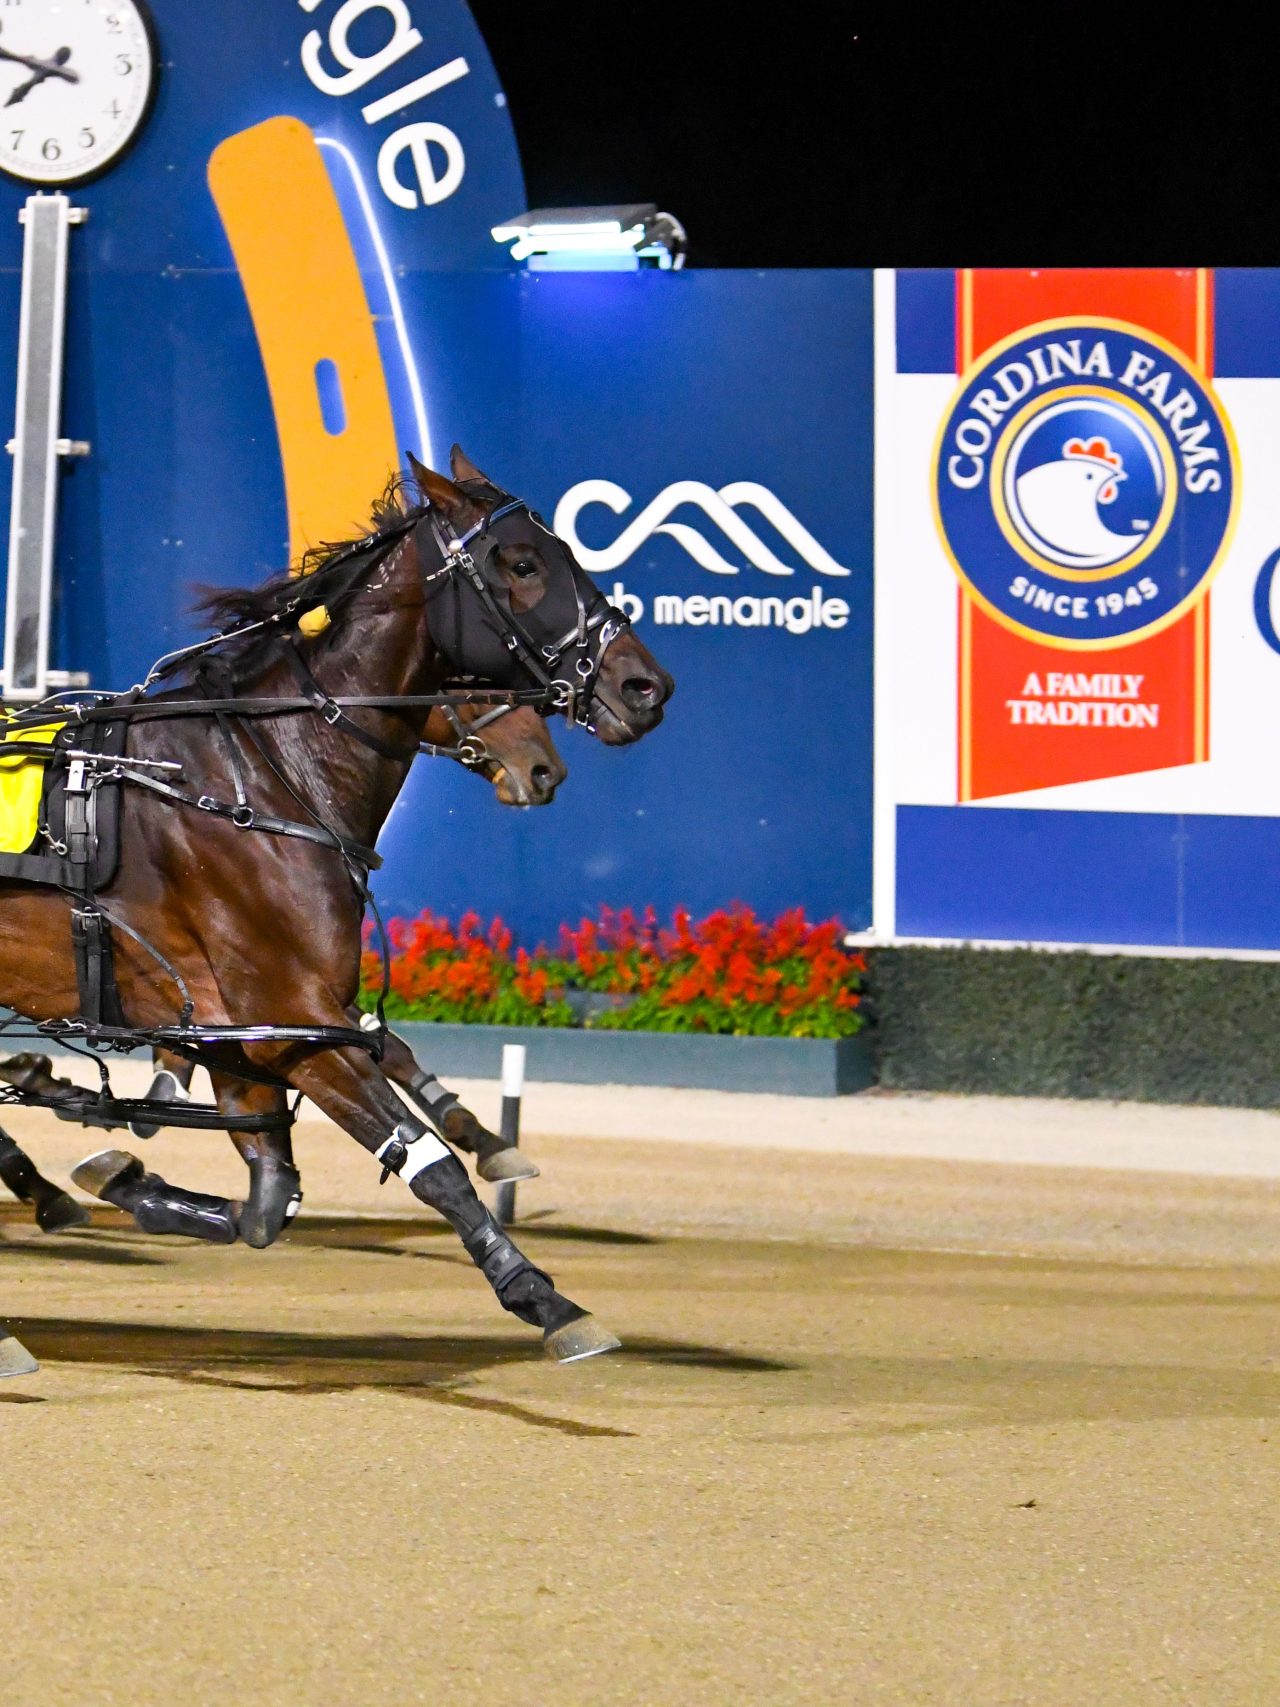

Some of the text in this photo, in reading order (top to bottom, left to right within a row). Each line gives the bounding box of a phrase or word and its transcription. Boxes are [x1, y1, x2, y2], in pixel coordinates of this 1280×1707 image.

[106, 13, 123, 34] 2
[114, 54, 132, 76] 3
[101, 98, 121, 119] 4
[298, 0, 470, 210] gle
[10, 130, 24, 151] 7
[41, 138, 61, 161] 6
[79, 127, 95, 149] 5
[948, 339, 1221, 494] CORDINA FARMS
[654, 585, 850, 634] menangle
[1009, 576, 1159, 619] SINCE 1945
[1022, 672, 1145, 699] A FAMILY
[1005, 700, 1159, 728] TRADITION
